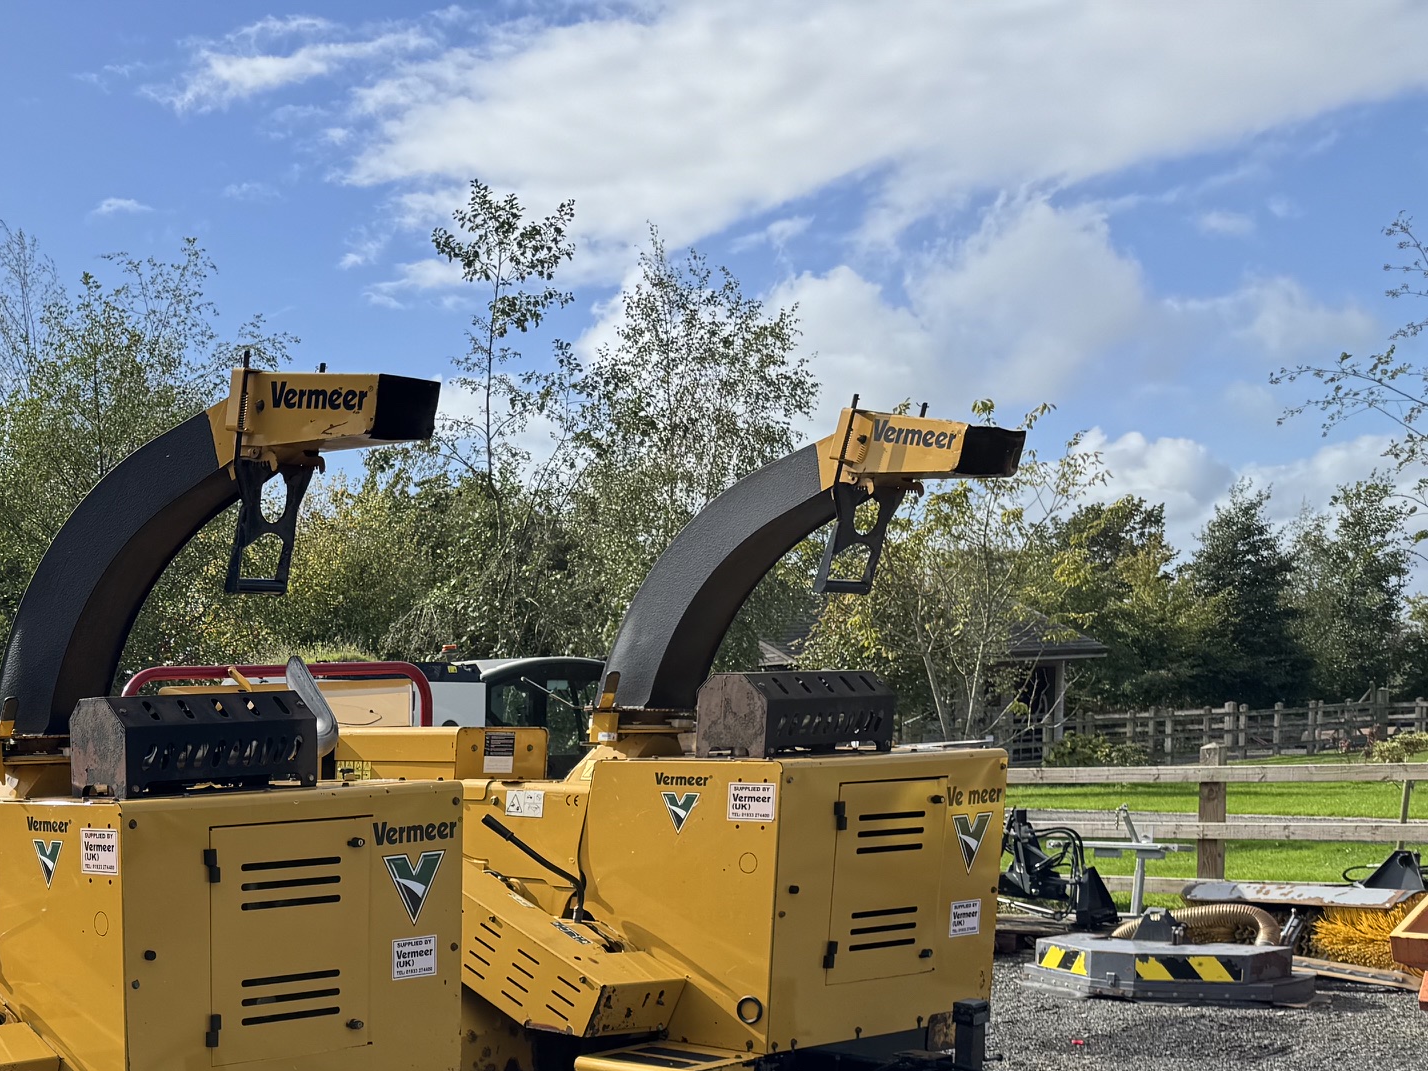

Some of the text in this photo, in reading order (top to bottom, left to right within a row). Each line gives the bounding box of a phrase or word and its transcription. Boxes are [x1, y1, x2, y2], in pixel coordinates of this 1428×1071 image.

[271, 381, 368, 410] Vermeer
[873, 419, 957, 449] Vermeer
[655, 772, 709, 786] Vermeer
[732, 793, 771, 803] Vermeer
[732, 803, 750, 811] (UK)
[27, 816, 69, 833] Vermeer
[373, 821, 457, 846] Vermeer
[84, 841, 114, 852] Vermeer
[85, 852, 99, 861] (UK)
[953, 911, 977, 919] Vermeer
[397, 940, 423, 948] SUPPLIED
[396, 949, 433, 960] Vermeer
[397, 959, 414, 968] (UK)
